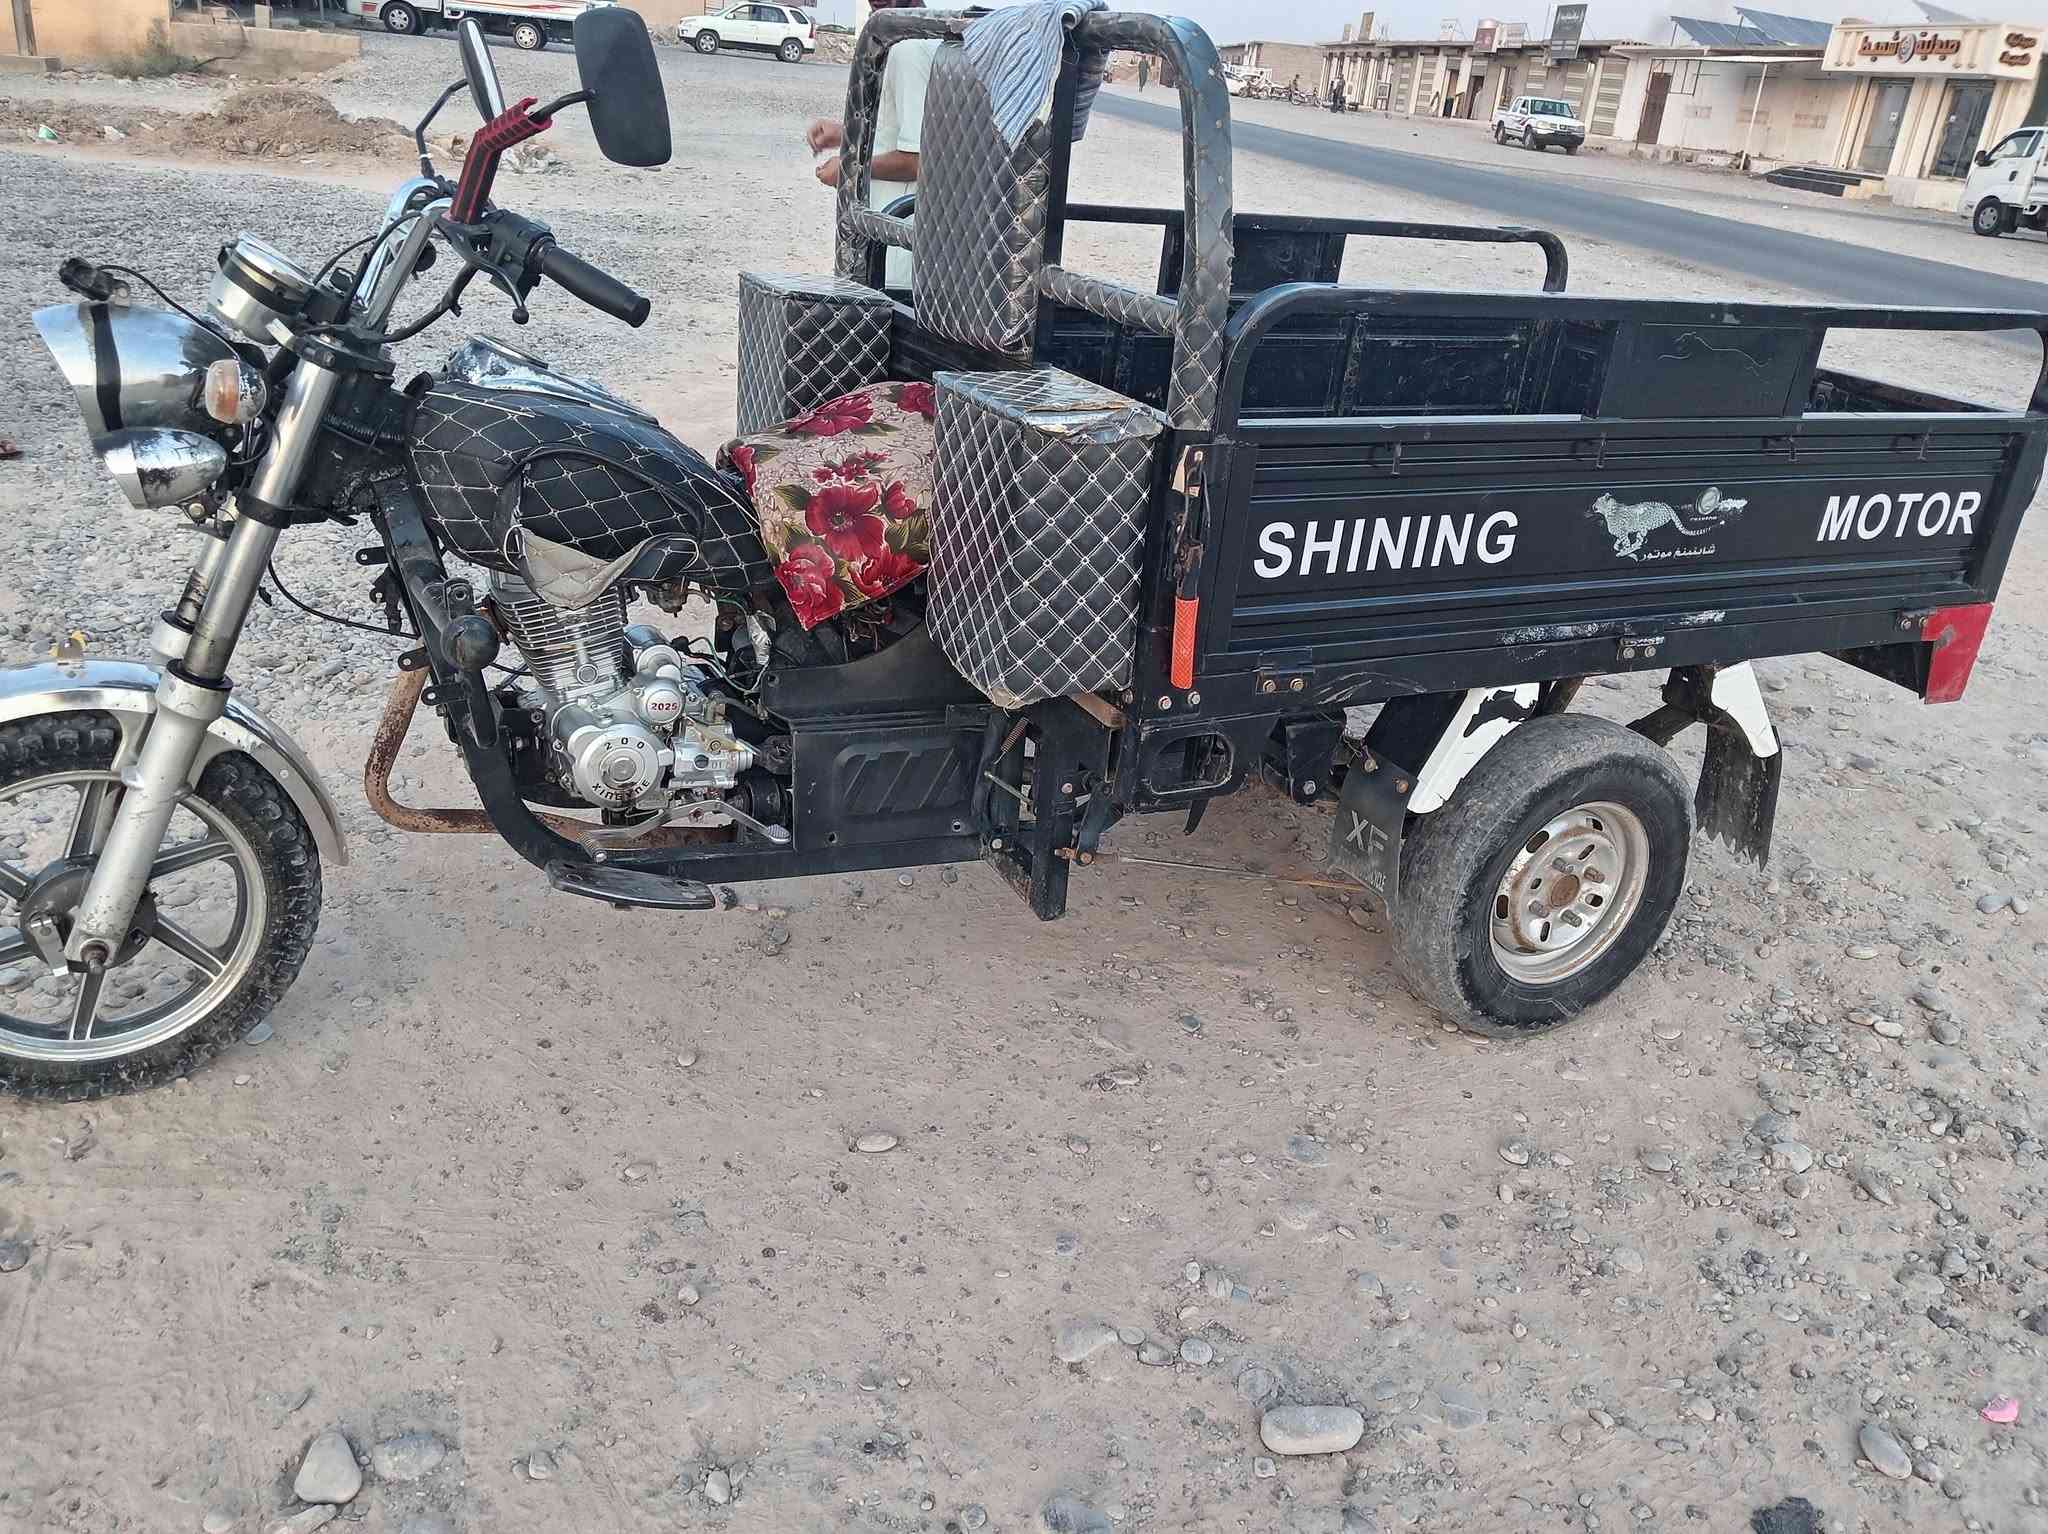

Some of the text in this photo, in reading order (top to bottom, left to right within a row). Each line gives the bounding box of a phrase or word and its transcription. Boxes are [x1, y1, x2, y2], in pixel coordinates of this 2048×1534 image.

[1915, 31, 1961, 61] صيدلية
[1254, 492, 1981, 578] SHINING MOTOR
[1639, 549, 1673, 562] موتور
[651, 702, 678, 711] 2025
[604, 736, 645, 751] 200
[1346, 809, 1389, 856] XF
